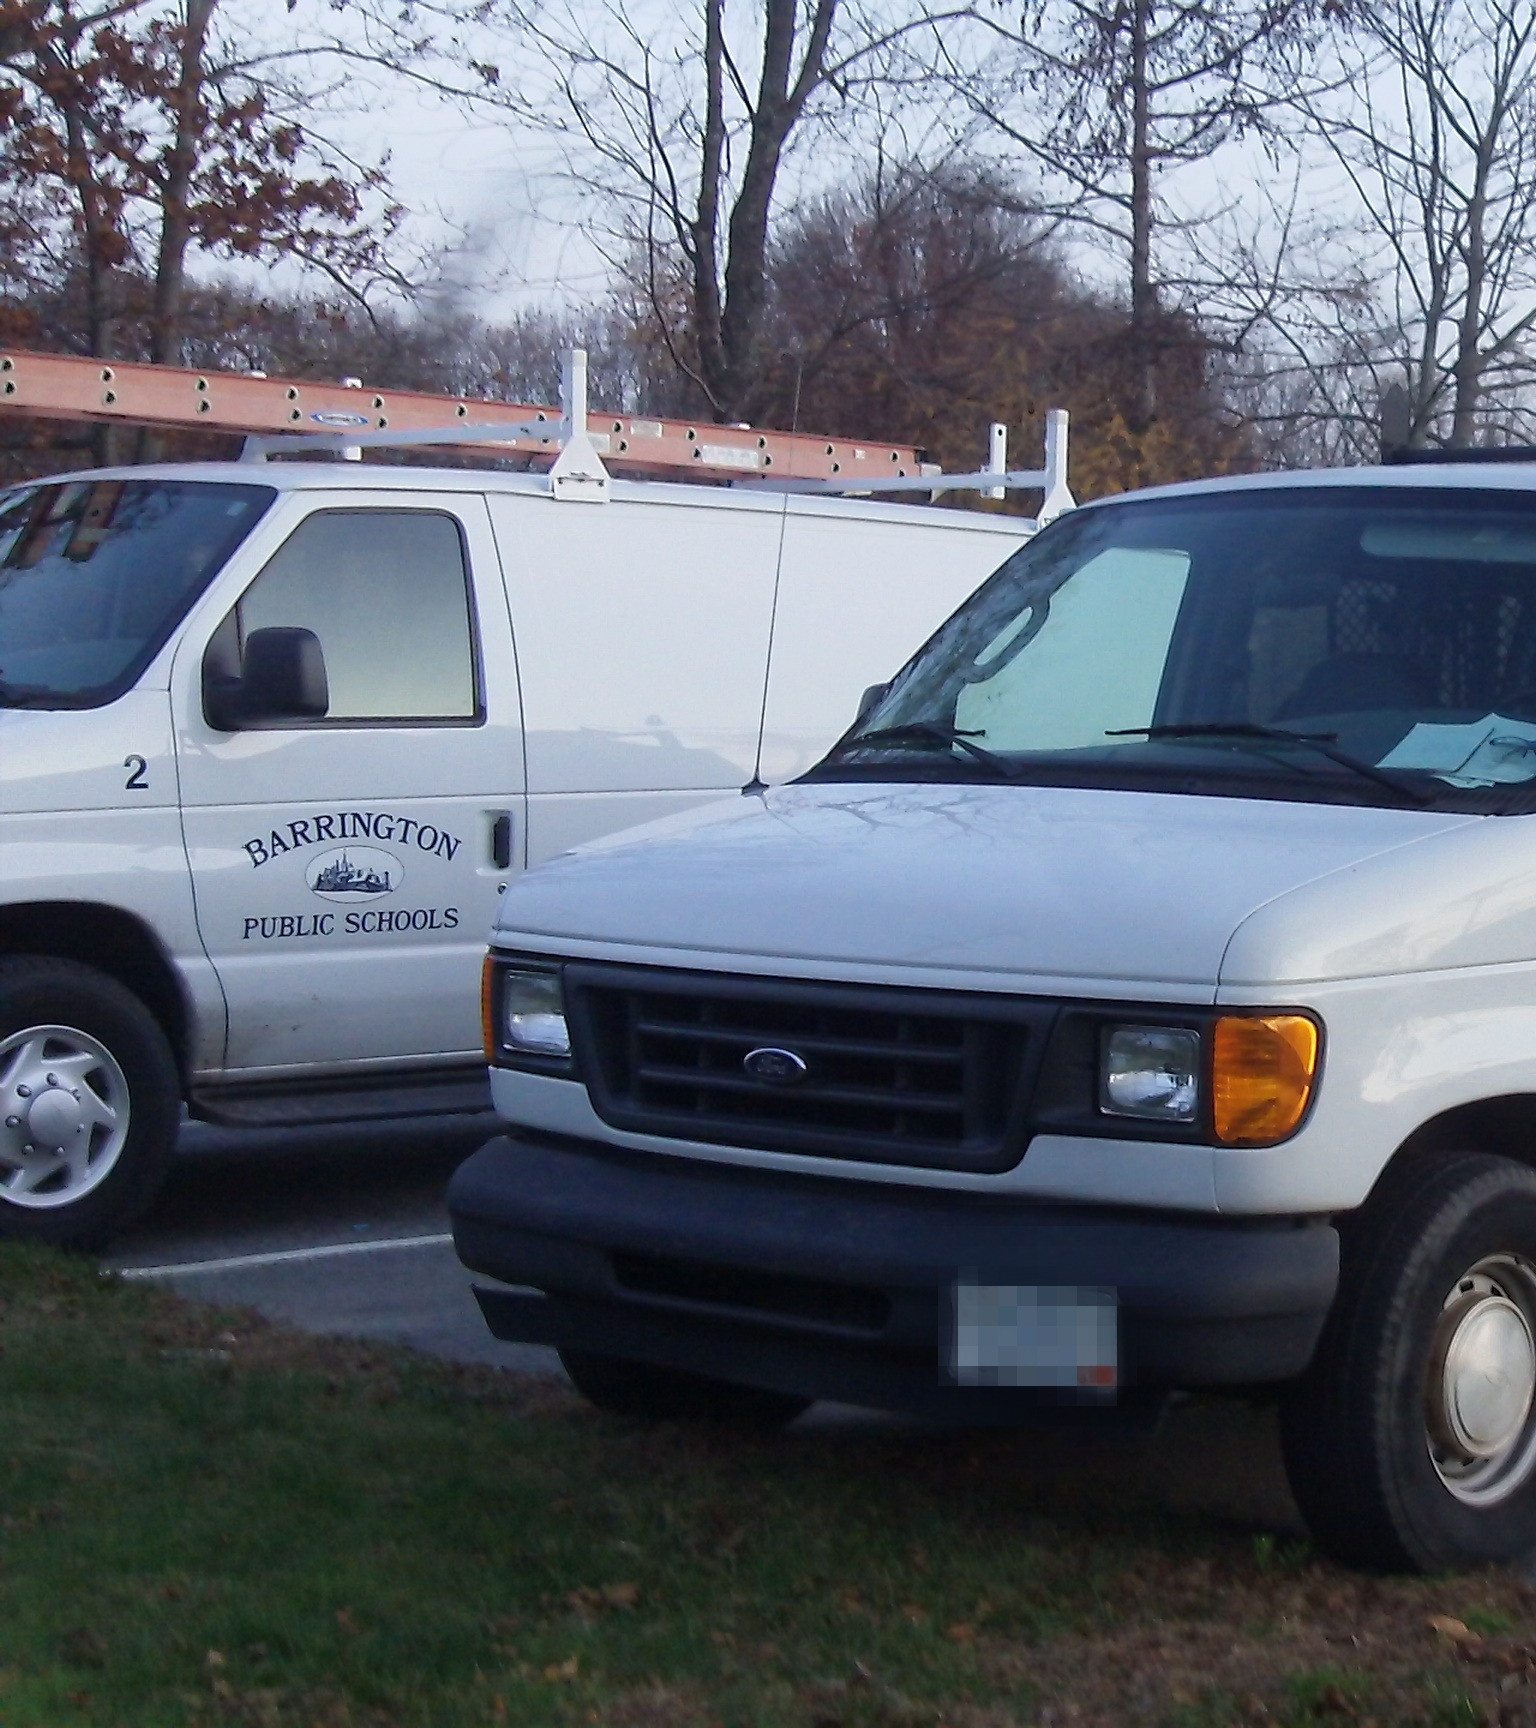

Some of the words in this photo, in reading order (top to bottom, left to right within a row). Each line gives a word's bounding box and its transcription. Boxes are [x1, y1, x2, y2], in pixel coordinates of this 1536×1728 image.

[124, 754, 149, 790] 2
[241, 812, 462, 869] BARRINGTON
[242, 913, 335, 940] PUBLIC
[345, 907, 459, 934] SCHOOLS
